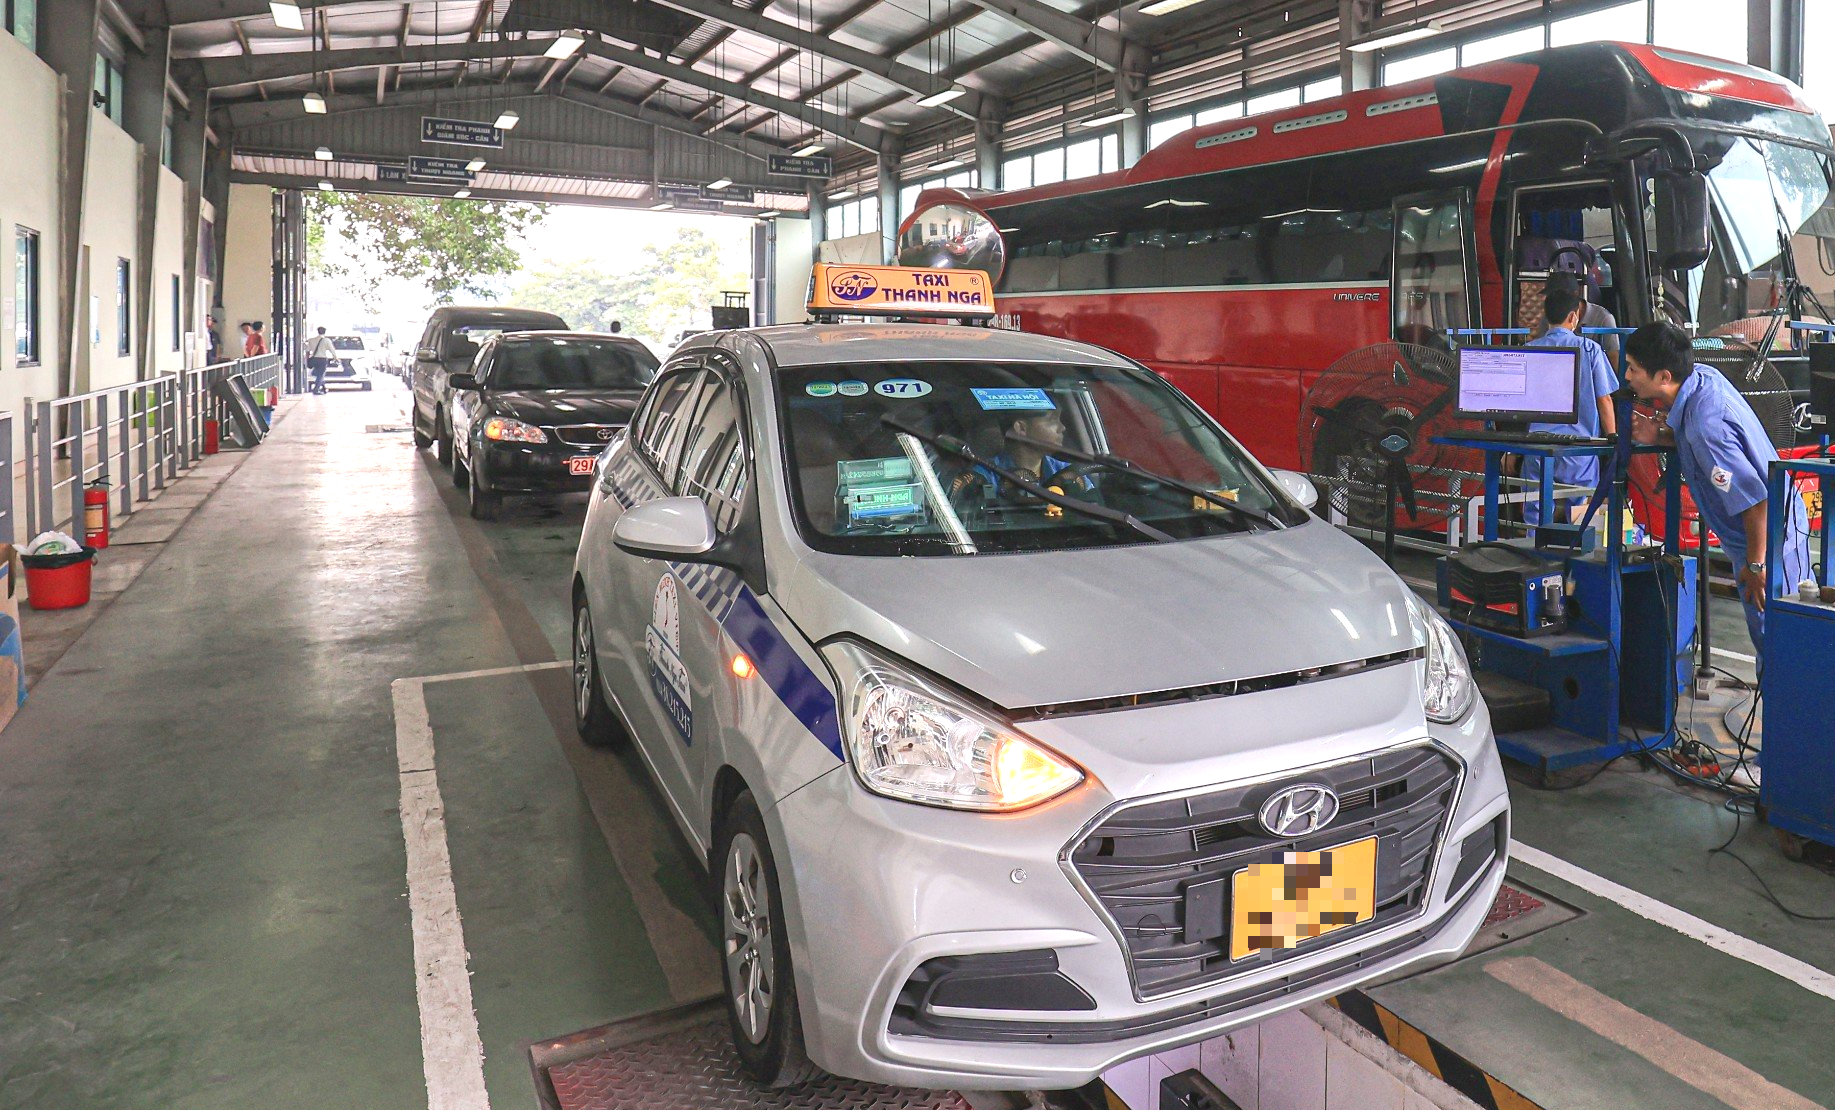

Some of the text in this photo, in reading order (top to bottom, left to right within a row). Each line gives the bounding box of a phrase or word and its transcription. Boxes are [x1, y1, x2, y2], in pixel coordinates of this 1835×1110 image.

[911, 273, 949, 287] TAXI
[881, 287, 981, 305] THANH NGA
[881, 382, 923, 394] 971
